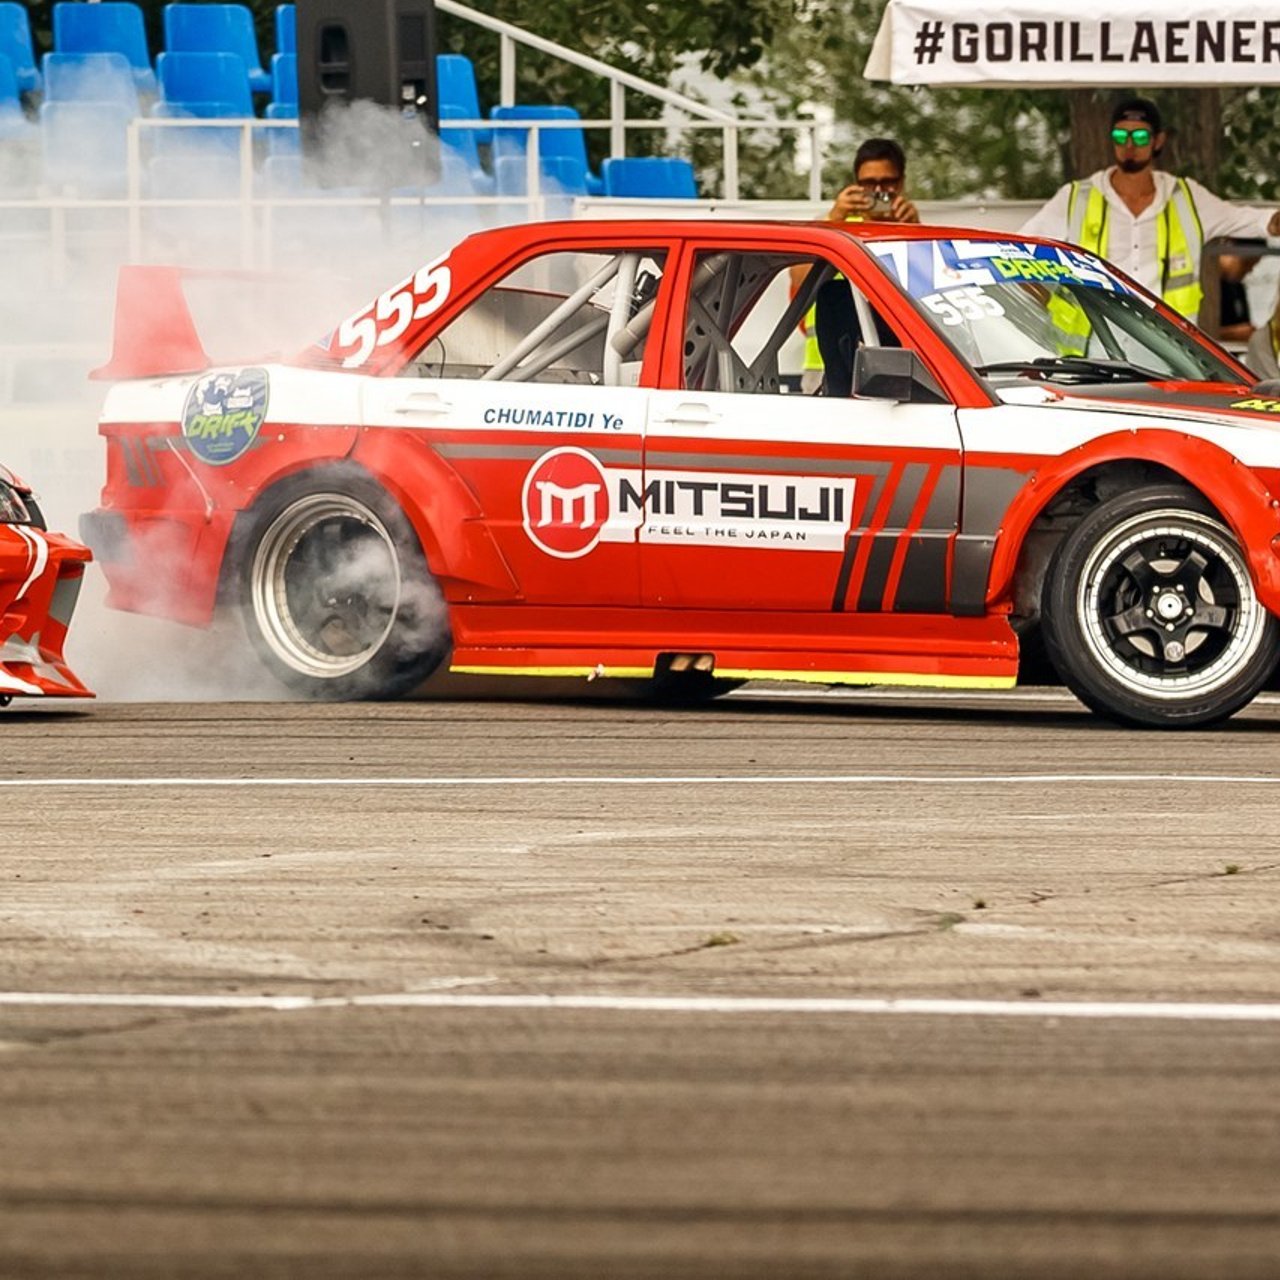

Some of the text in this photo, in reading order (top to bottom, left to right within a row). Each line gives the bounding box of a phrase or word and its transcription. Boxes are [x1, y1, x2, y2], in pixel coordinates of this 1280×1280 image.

[913, 20, 1280, 64] #GORILLAENER
[337, 248, 451, 368] 555
[921, 286, 1006, 326] 555
[483, 408, 624, 430] CHUMATIDI Ye
[618, 477, 844, 523] MITSUJI
[647, 525, 807, 541] FEEL THE JAPAN
